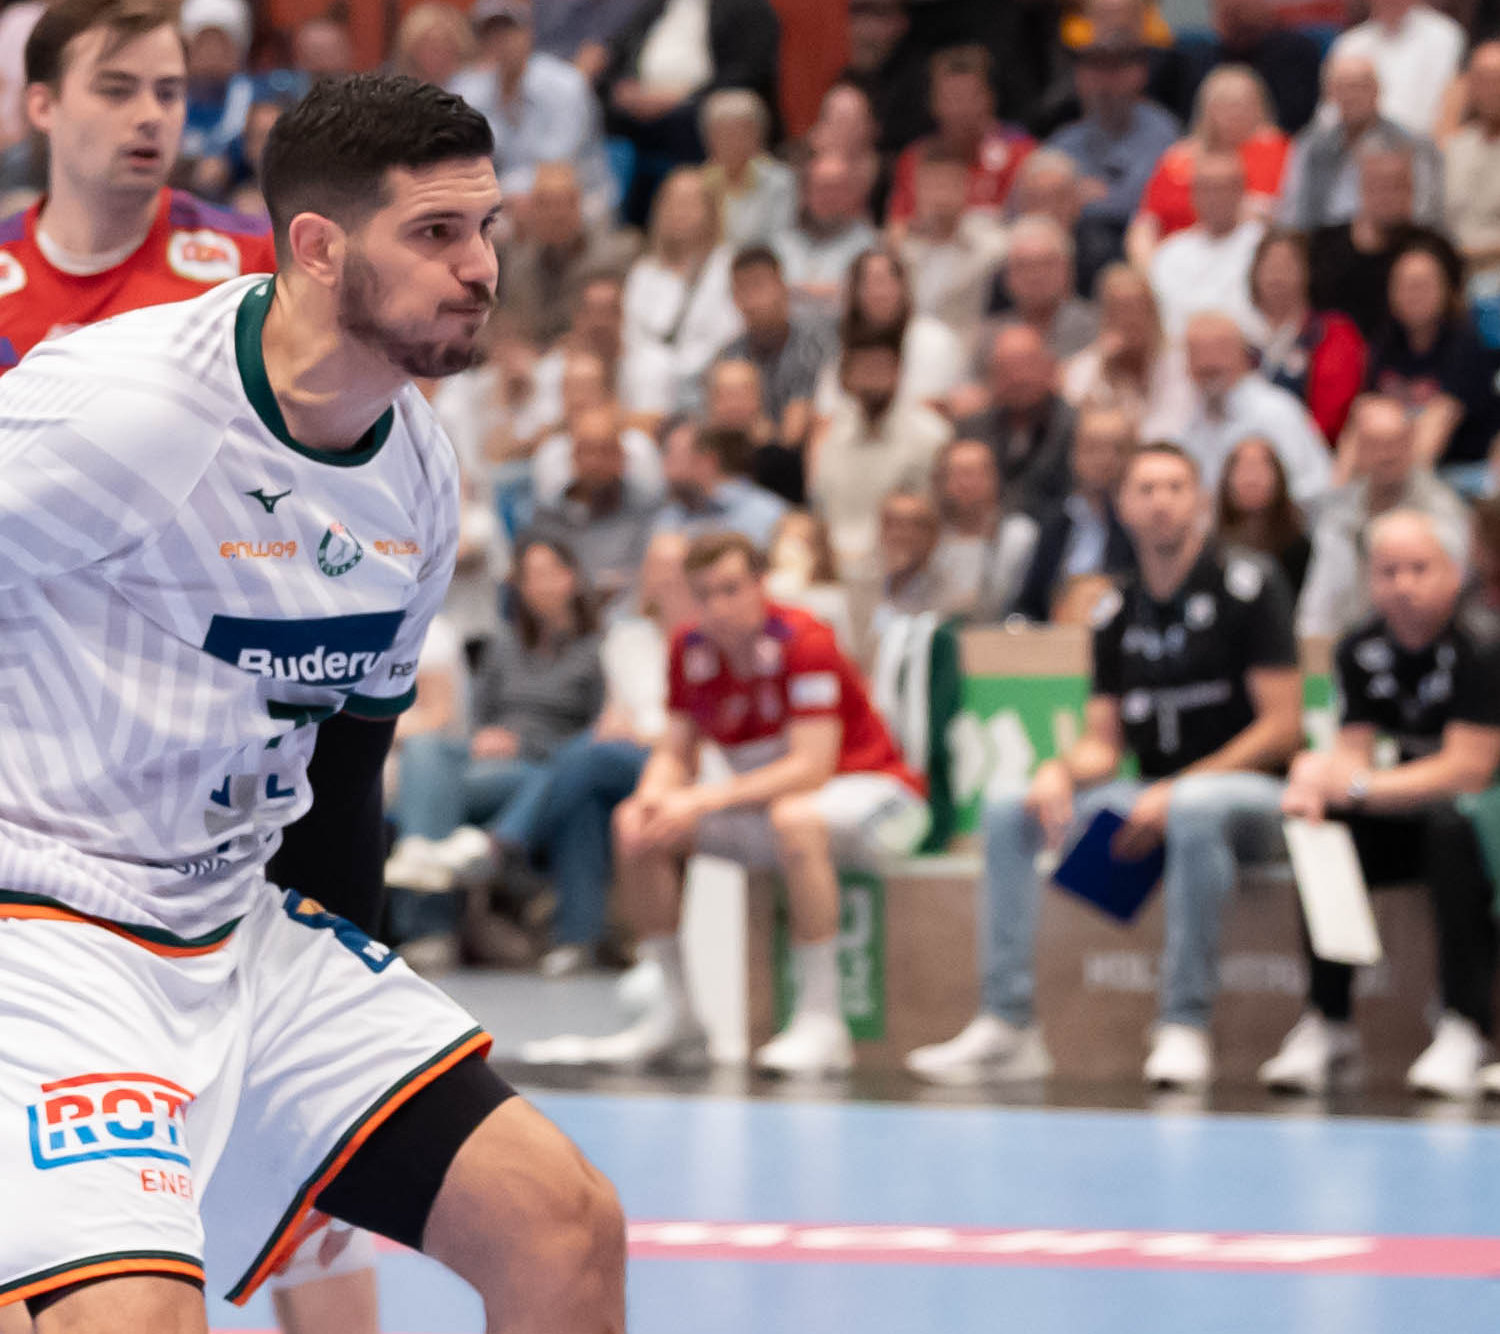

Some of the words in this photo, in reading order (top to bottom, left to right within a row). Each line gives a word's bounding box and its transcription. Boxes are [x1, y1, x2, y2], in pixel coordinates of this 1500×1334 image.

[236, 645, 384, 683] Buderu
[44, 1087, 187, 1151] ROT
[140, 1169, 193, 1202] ENE
